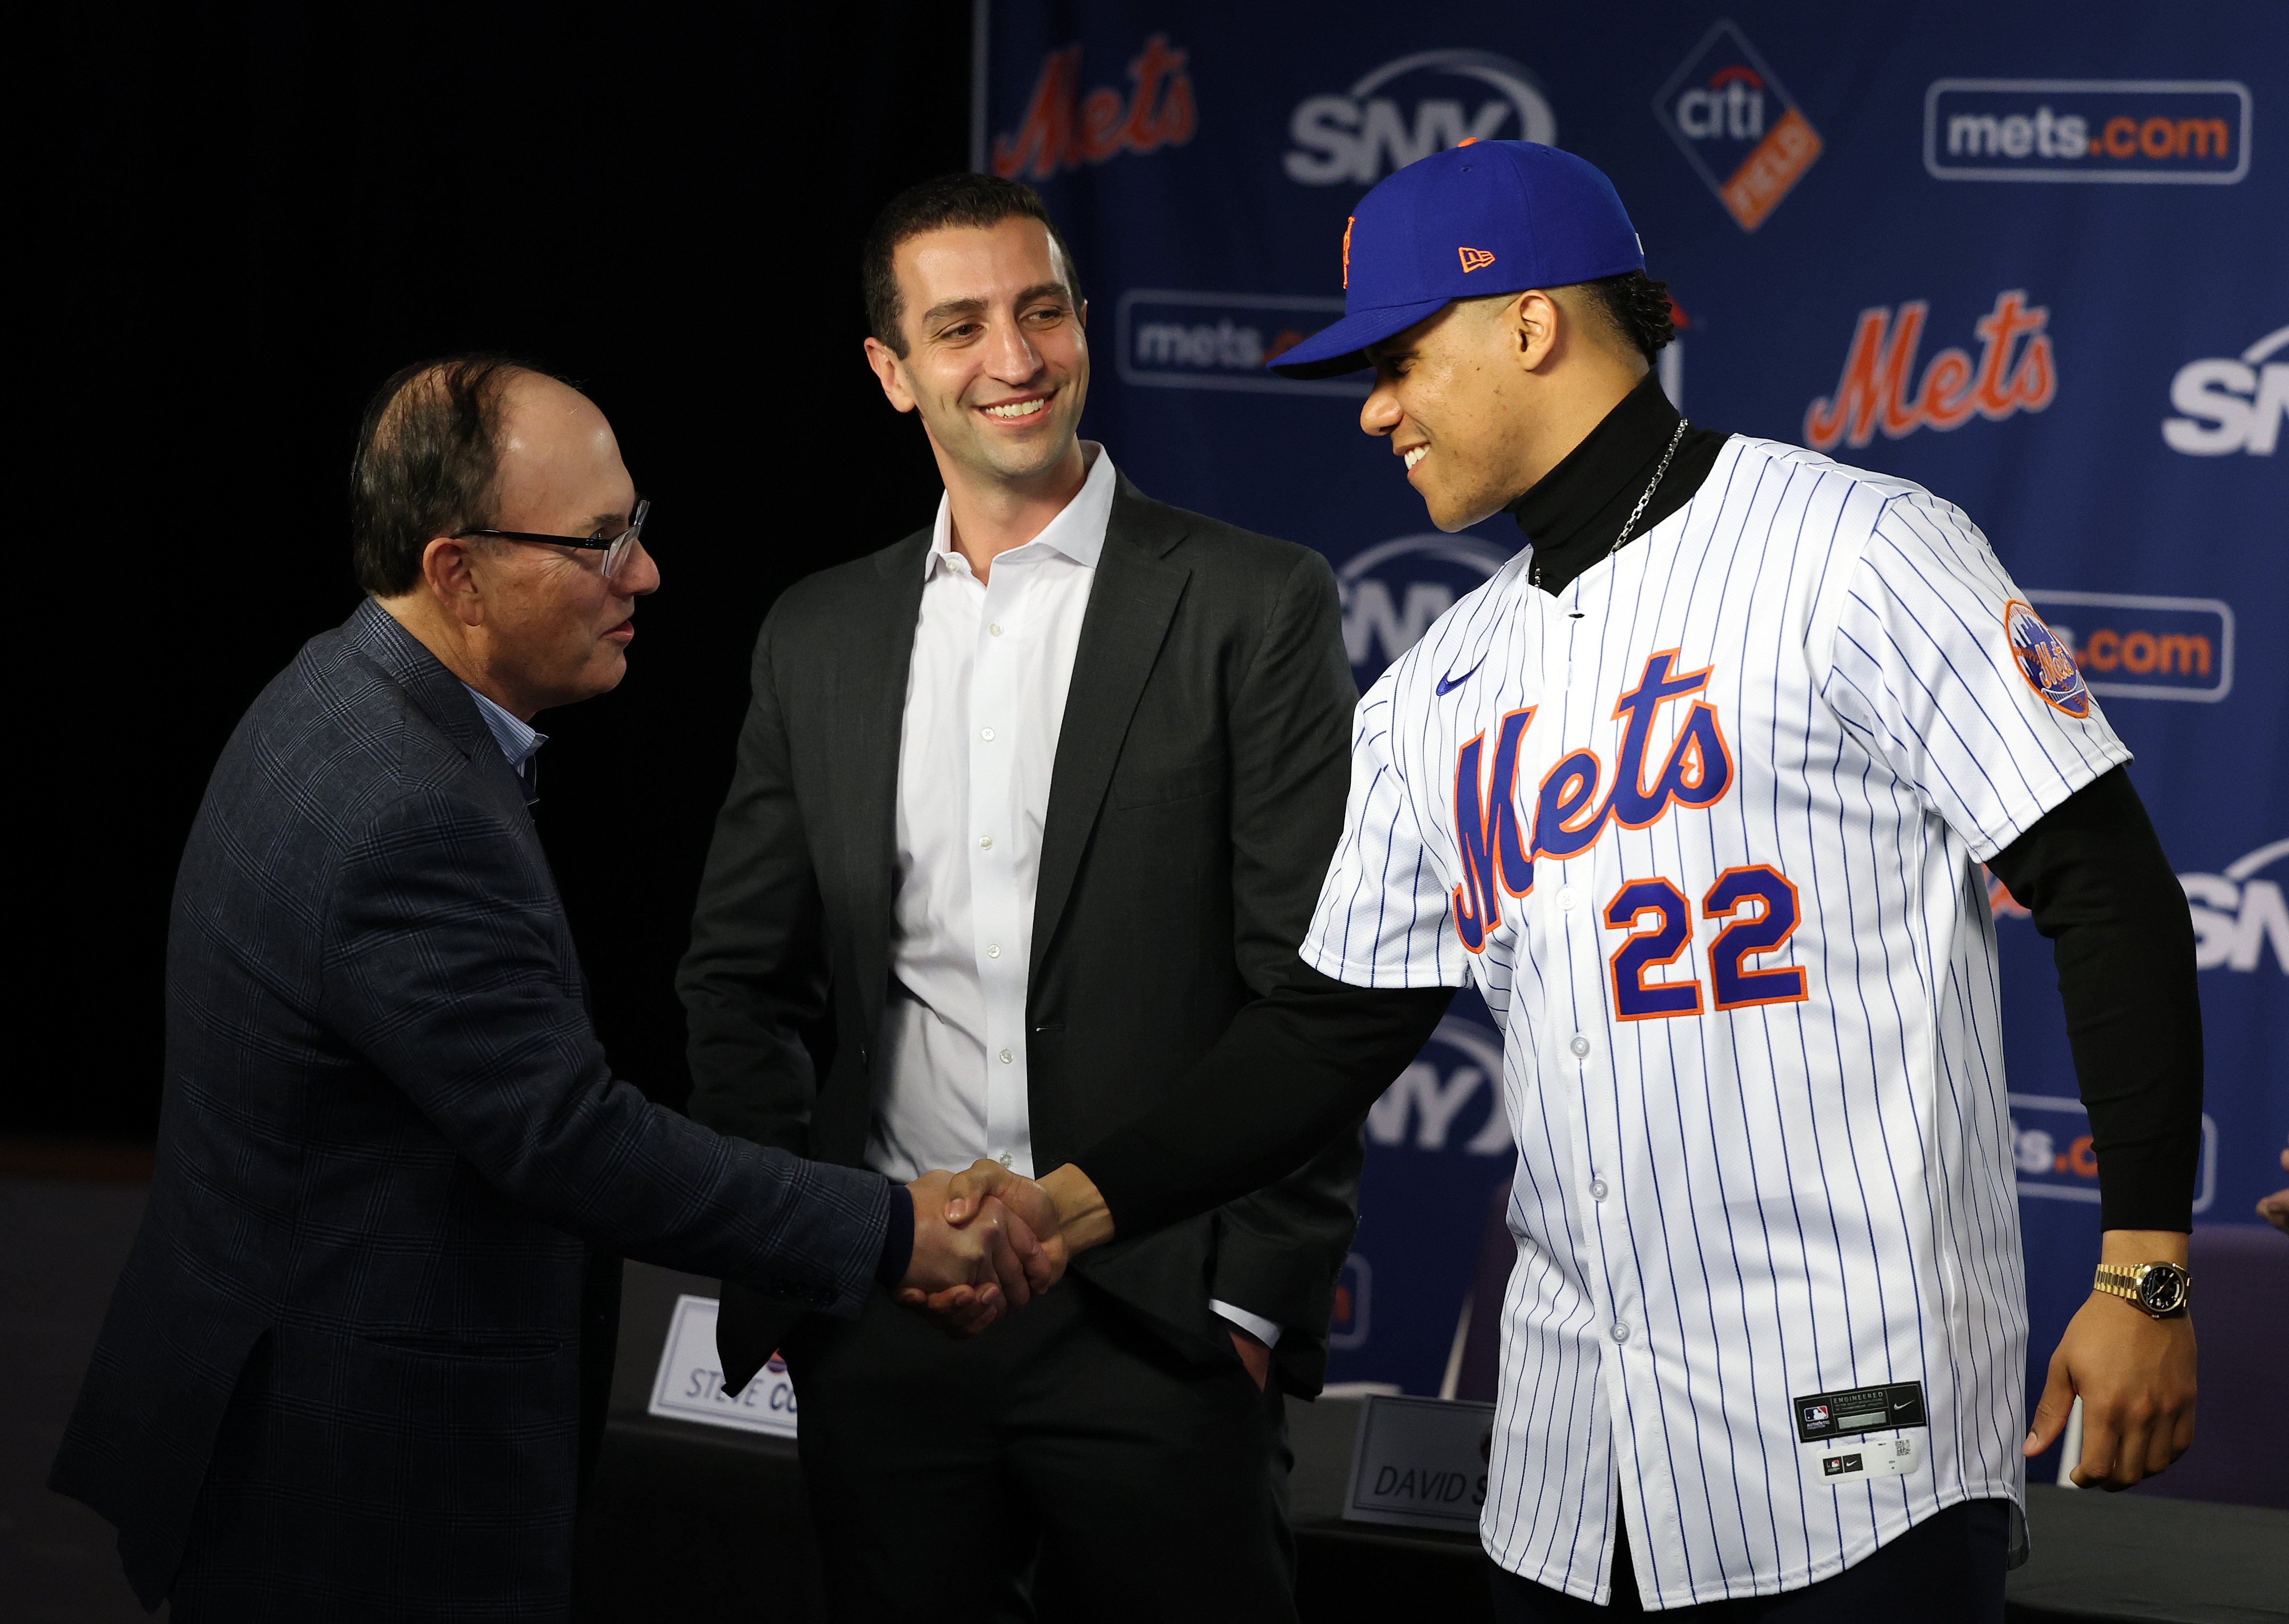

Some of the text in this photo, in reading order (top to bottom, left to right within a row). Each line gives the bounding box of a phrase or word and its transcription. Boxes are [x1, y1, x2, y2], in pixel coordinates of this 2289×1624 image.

[991, 32, 1199, 180] Mets
[1677, 78, 1764, 140] citi
[1948, 104, 2230, 160] mets.com
[1731, 122, 1810, 217] FIELD
[1137, 317, 1305, 369] mets.
[1802, 289, 2057, 452] Mets
[2035, 641, 2074, 689] Mets
[2052, 625, 2212, 676] .com
[1453, 647, 1733, 954] Mets
[1603, 863, 1808, 1022] 22
[685, 1367, 763, 1408] STE
[1375, 1465, 1467, 1502] DAVID
